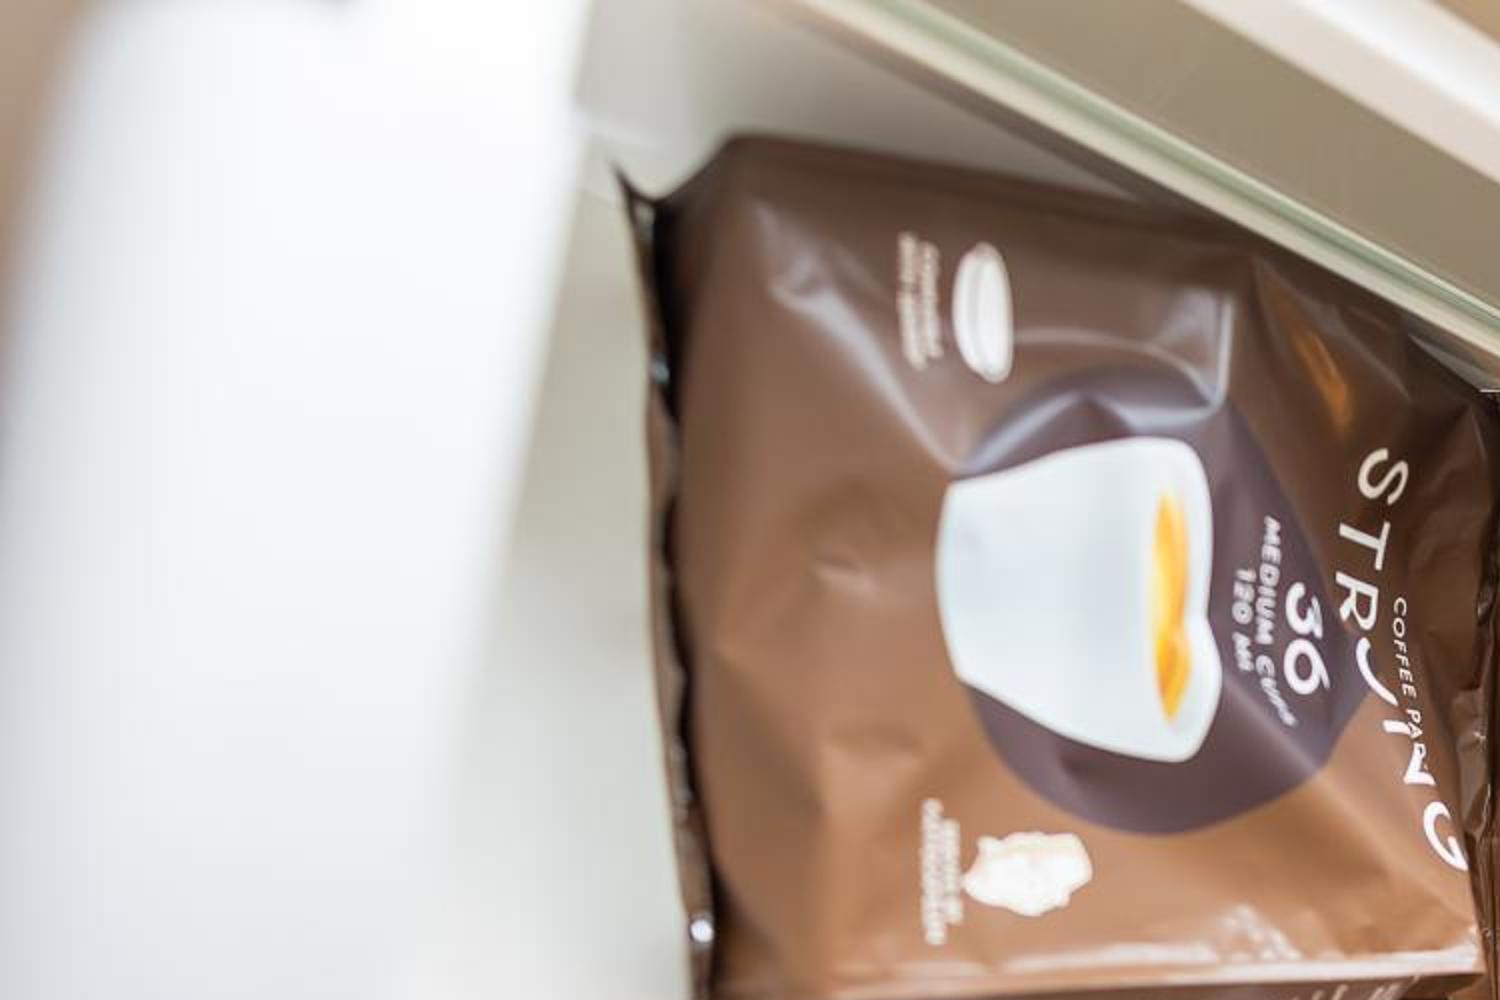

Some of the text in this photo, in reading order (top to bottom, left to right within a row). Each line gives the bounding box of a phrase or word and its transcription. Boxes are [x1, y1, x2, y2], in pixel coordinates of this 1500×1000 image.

[1232, 568, 1256, 626] 120
[1255, 515, 1282, 645] MEDIUM
[1283, 582, 1330, 695] 36
[1392, 597, 1417, 698] COFFEE
